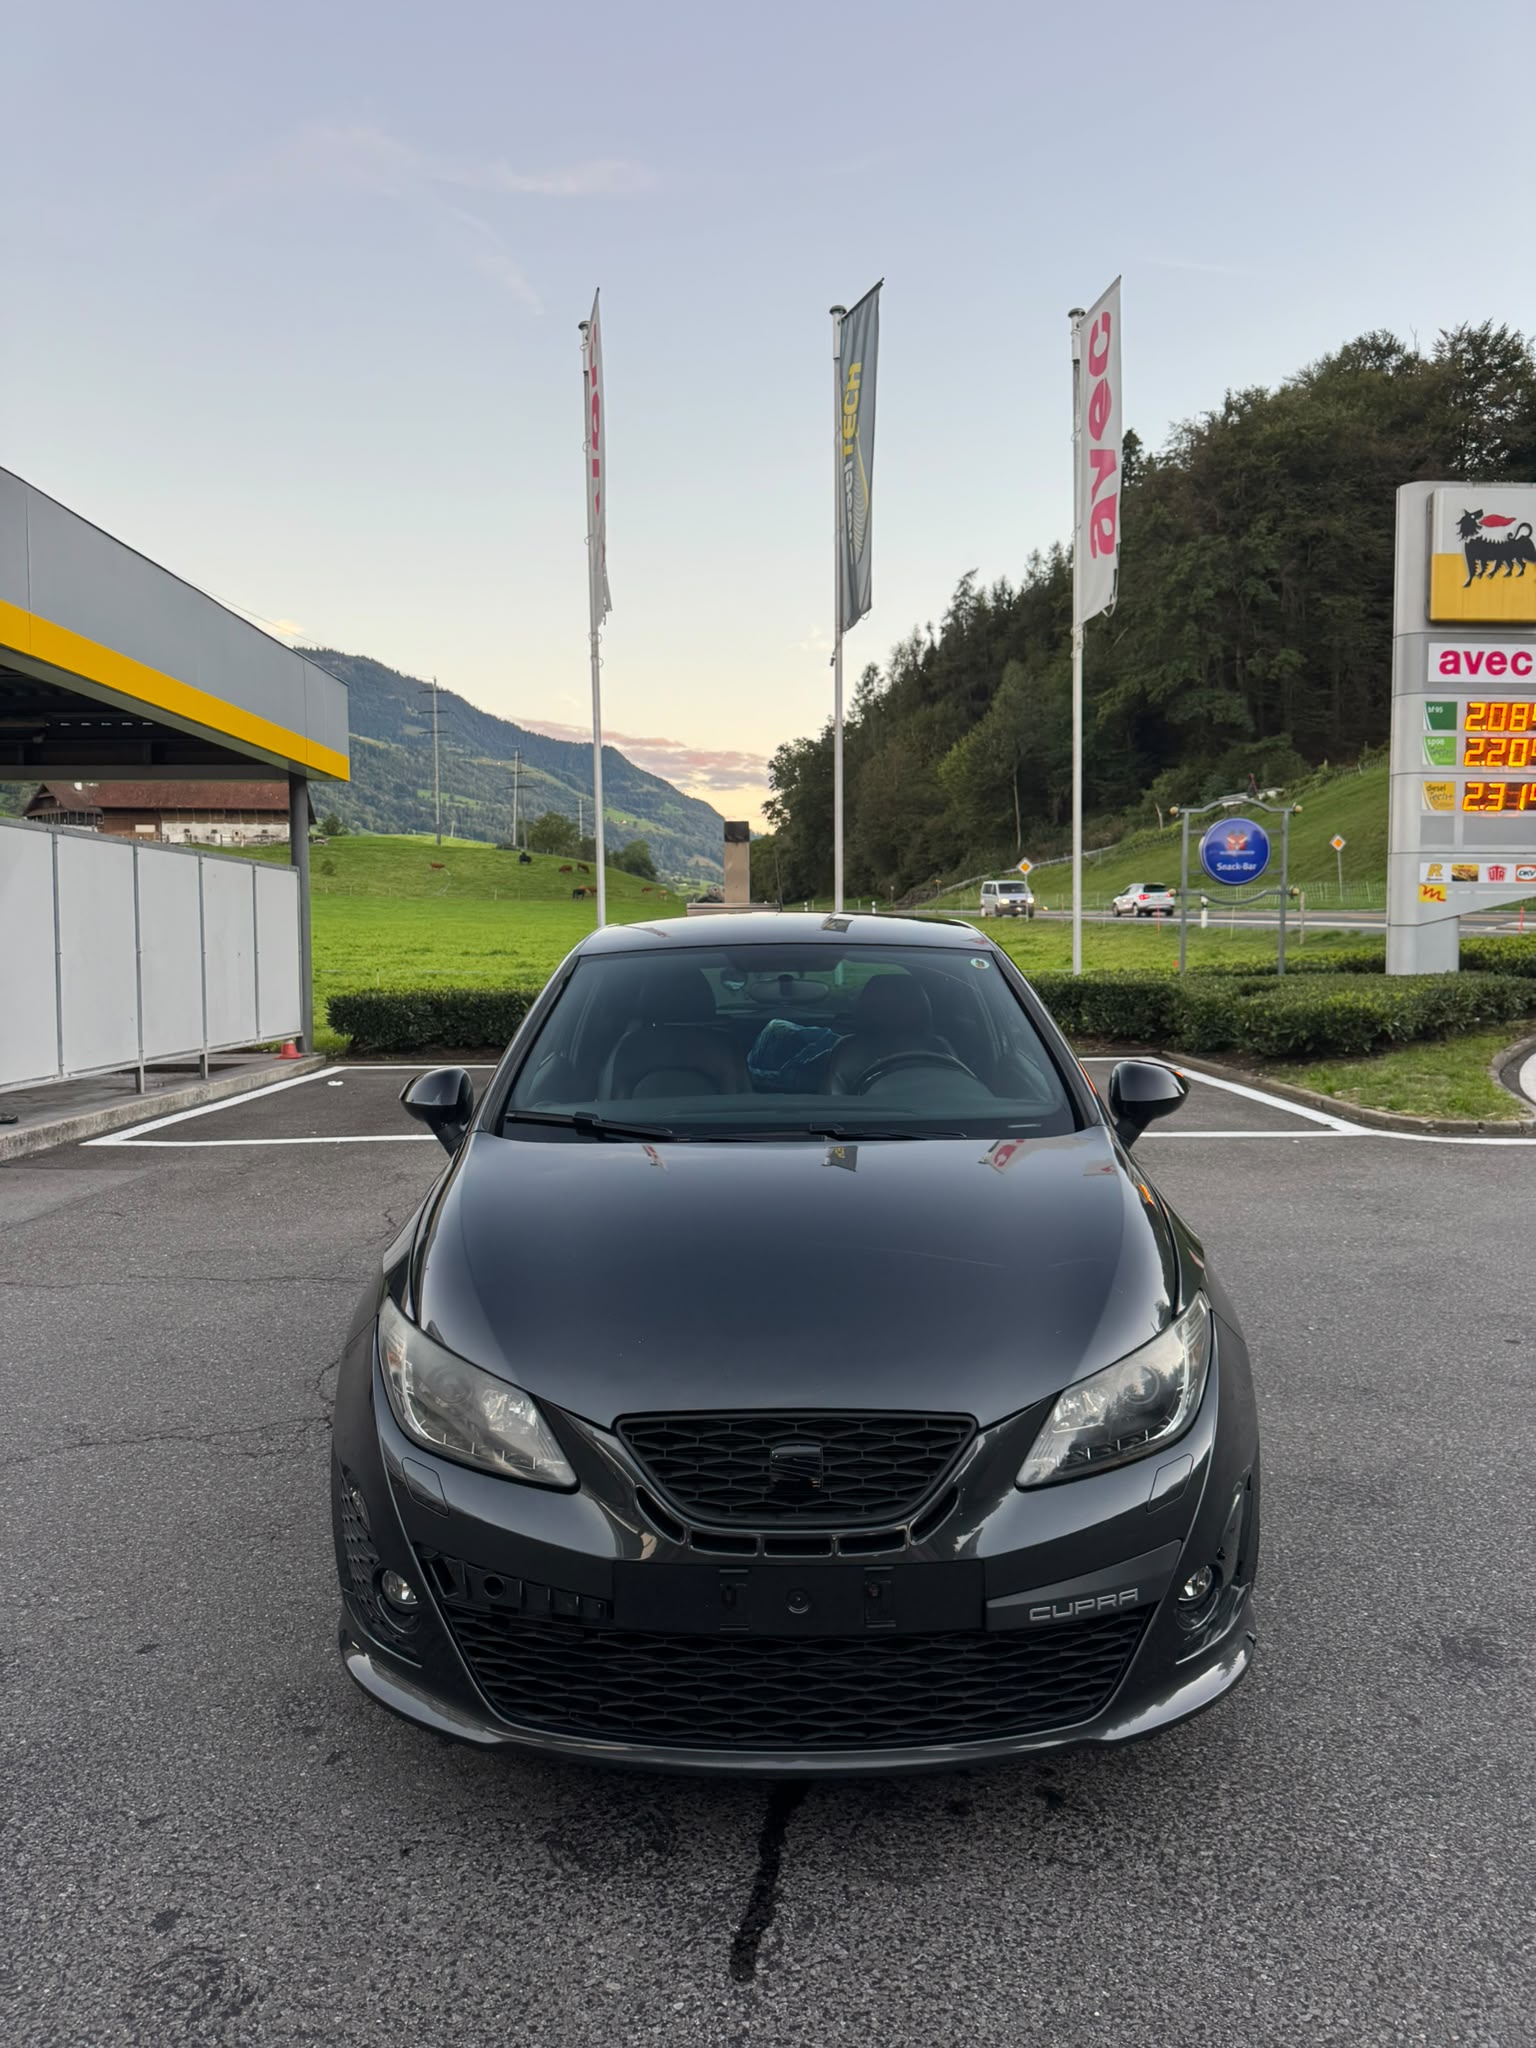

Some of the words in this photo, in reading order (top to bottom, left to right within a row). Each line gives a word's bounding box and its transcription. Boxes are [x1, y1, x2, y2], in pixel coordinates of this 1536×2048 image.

[1088, 312, 1117, 560] avec
[1438, 650, 1533, 676] avec
[1464, 703, 1536, 731] 2.08
[1463, 738, 1536, 767] 2.20
[1216, 862, 1257, 872] Snack-Bar
[1029, 1588, 1139, 1621] CUPRA
